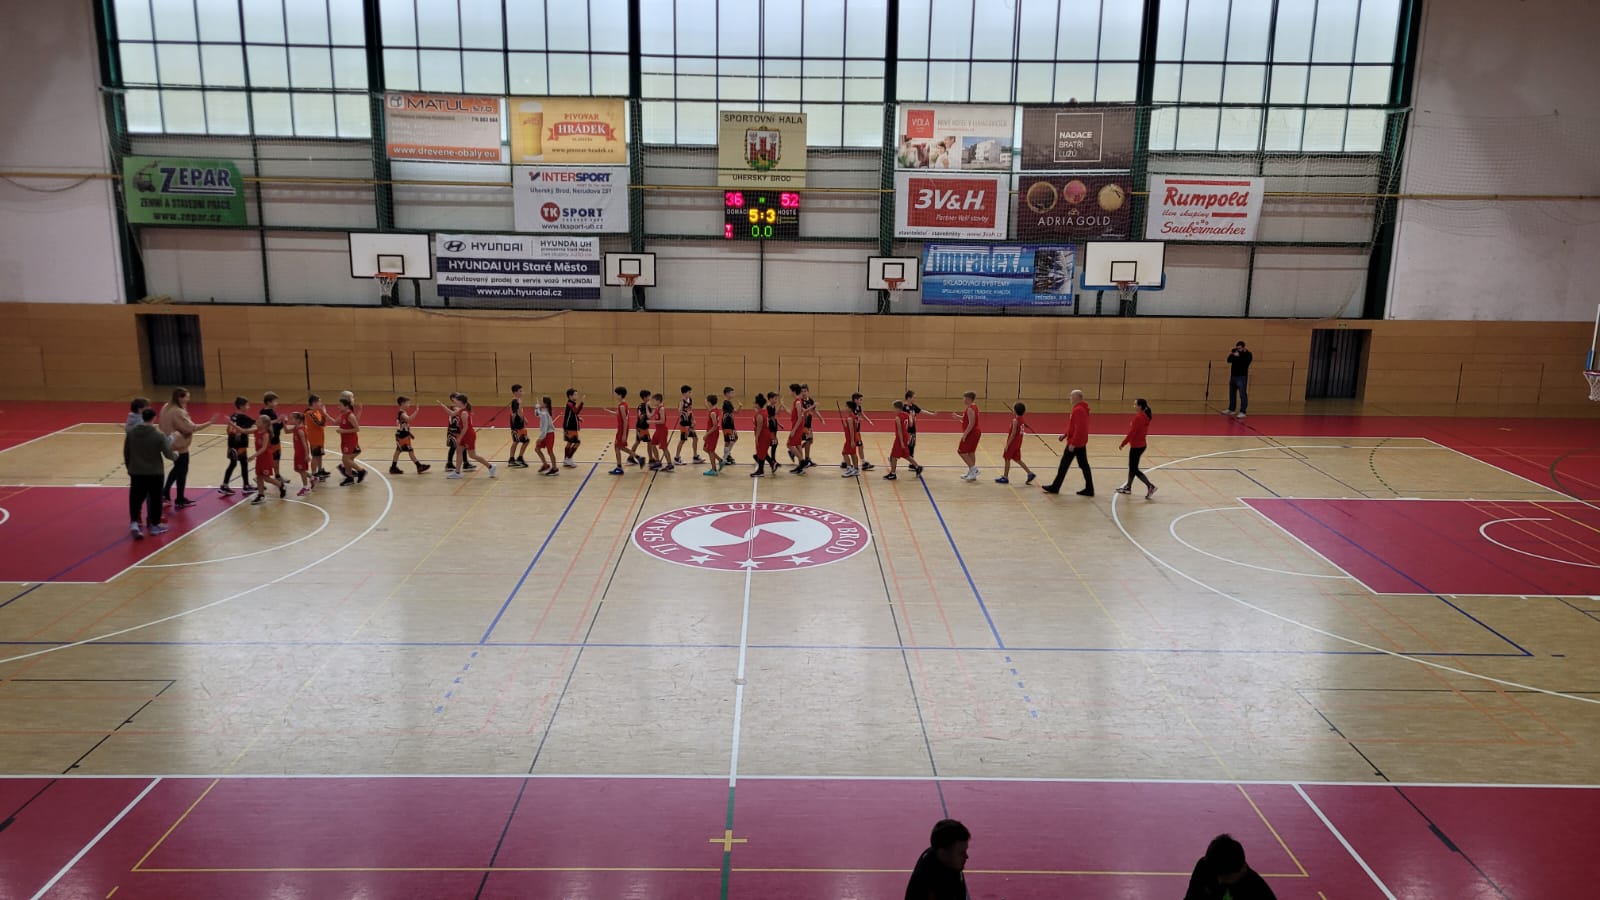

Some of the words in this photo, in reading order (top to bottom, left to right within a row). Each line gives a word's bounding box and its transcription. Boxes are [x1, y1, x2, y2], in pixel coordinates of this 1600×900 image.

[407, 98, 469, 110] MATUL
[779, 115, 803, 124] HALA
[558, 123, 606, 134] HRÁDEK
[1059, 131, 1093, 139] NADACE
[393, 146, 496, 158] www.drevene-obaly.eu
[160, 167, 231, 192] ZEPAR
[541, 171, 613, 182] INTERSPORT
[725, 191, 744, 207] 36
[781, 192, 800, 208] 52
[914, 188, 985, 210] 3V&H
[1163, 187, 1250, 209] Rumpold
[543, 207, 559, 217] TK
[562, 208, 603, 218] SPORT
[748, 208, 776, 223] 5:3
[1160, 221, 1247, 235] Saubermacher
[471, 241, 523, 252] HYUNDAI
[448, 260, 501, 271] HYUNDAI
[503, 261, 520, 271] UH
[522, 261, 552, 272] Staré
[554, 261, 588, 272] Město
[476, 288, 563, 297] www.uh.hyundai.cz
[643, 505, 722, 542] SPARTAK
[824, 527, 860, 554] BROD
[650, 543, 680, 555] TJ
